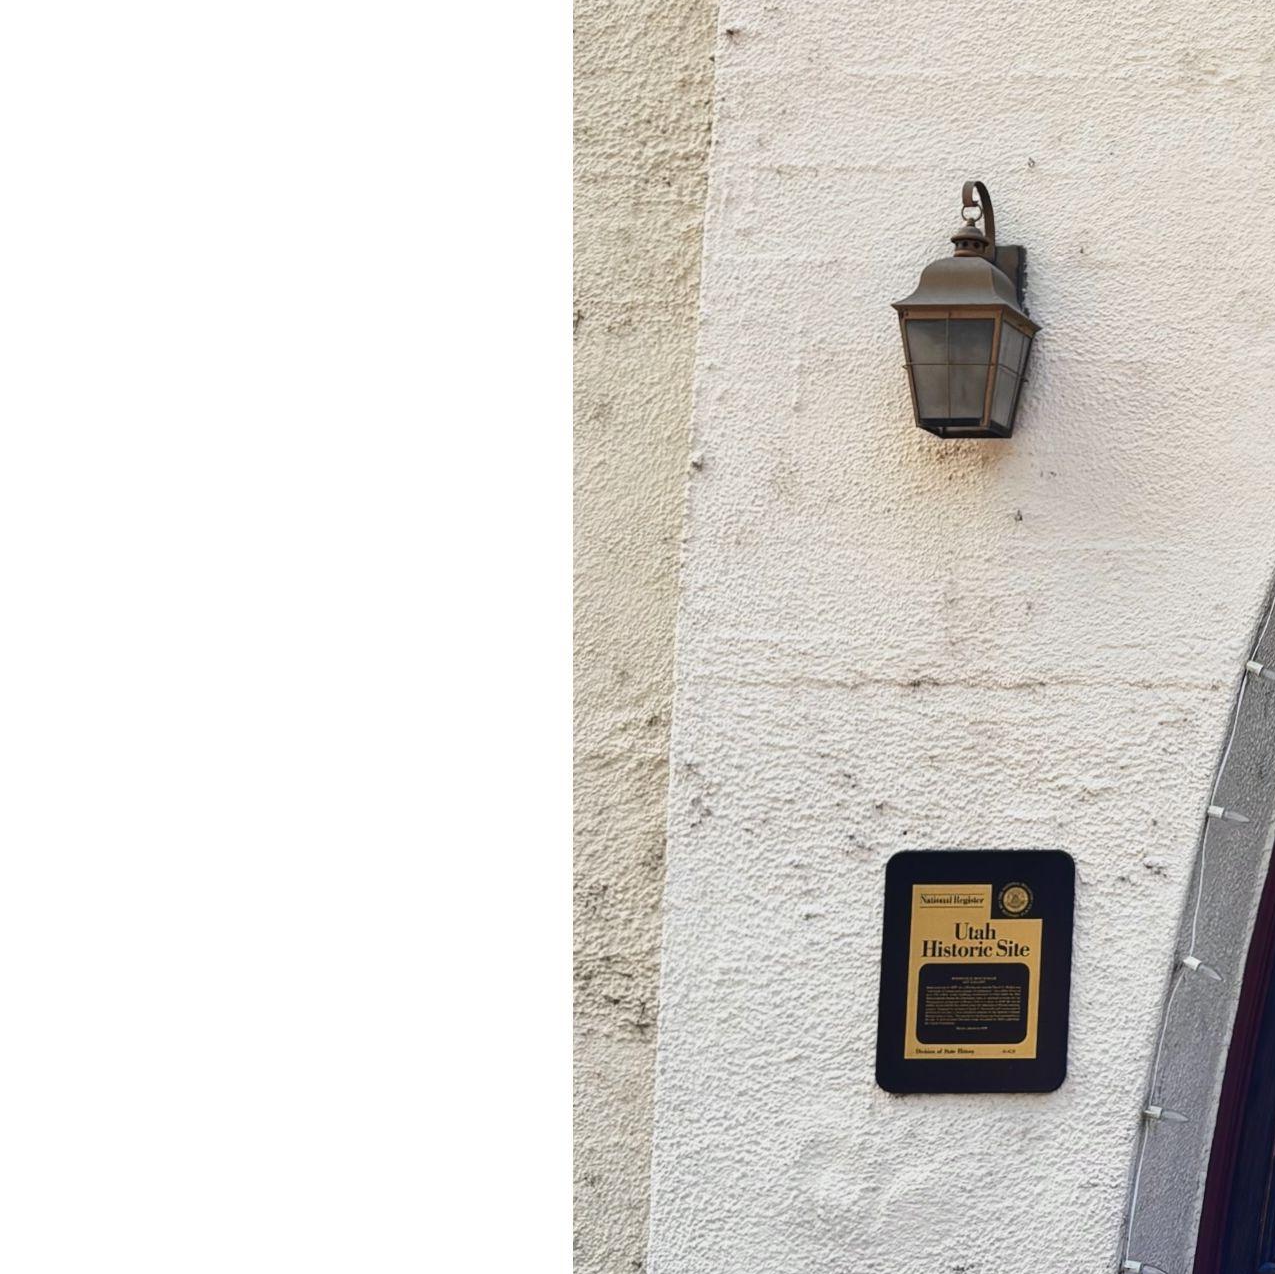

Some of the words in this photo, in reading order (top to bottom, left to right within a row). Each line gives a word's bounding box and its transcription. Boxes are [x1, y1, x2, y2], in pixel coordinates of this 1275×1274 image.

[920, 893, 953, 904] National
[953, 894, 985, 905] Register
[954, 922, 997, 941] Utah
[921, 940, 993, 958] Historic
[995, 939, 1030, 958] Site
